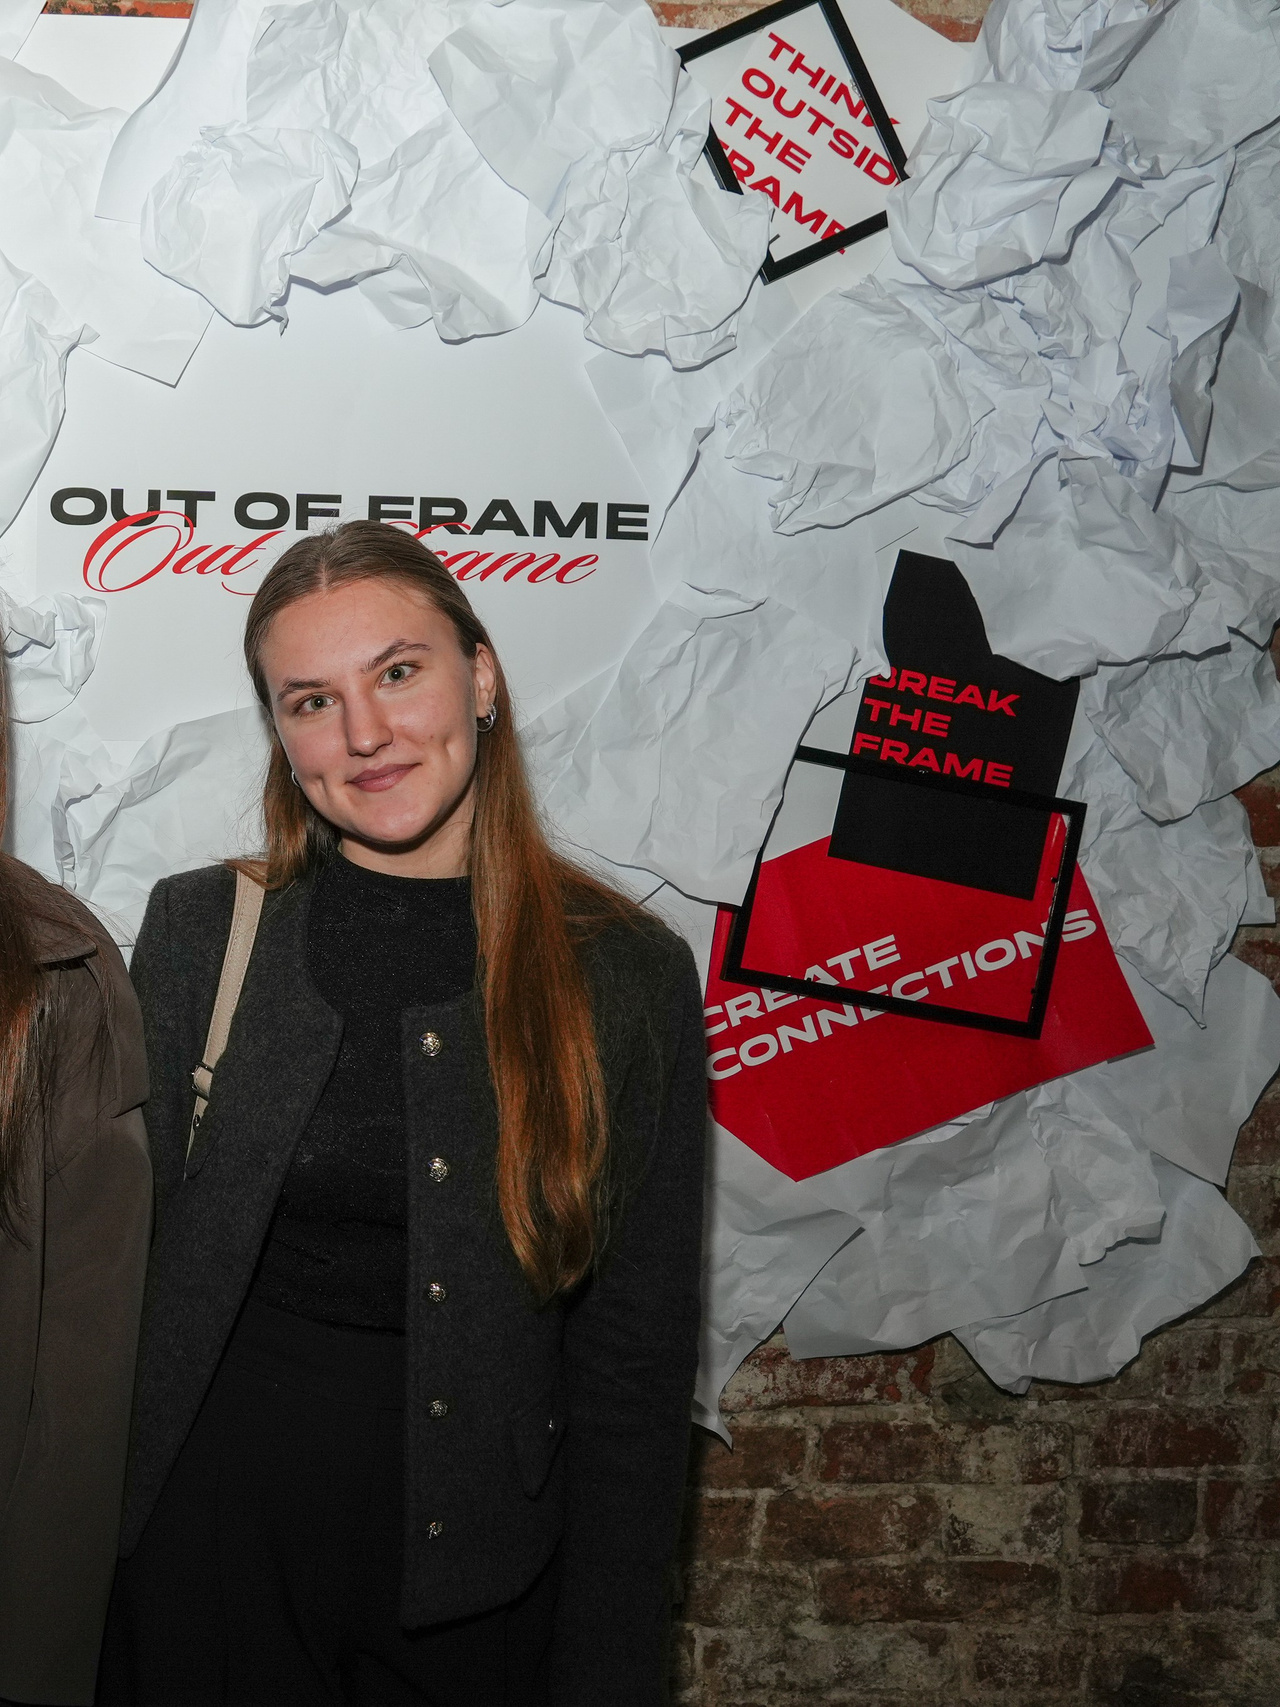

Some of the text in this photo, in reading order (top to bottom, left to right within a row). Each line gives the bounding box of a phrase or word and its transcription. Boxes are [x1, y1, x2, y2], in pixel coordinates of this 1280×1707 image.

[725, 96, 812, 175] THE
[741, 67, 901, 188] OUTSID
[718, 138, 847, 255] RAM
[50, 487, 650, 541] OUT OF FRAME
[83, 510, 600, 593] Out ame
[863, 697, 951, 738] THE
[868, 666, 1020, 717] BREAK
[852, 731, 1014, 788] FRAME
